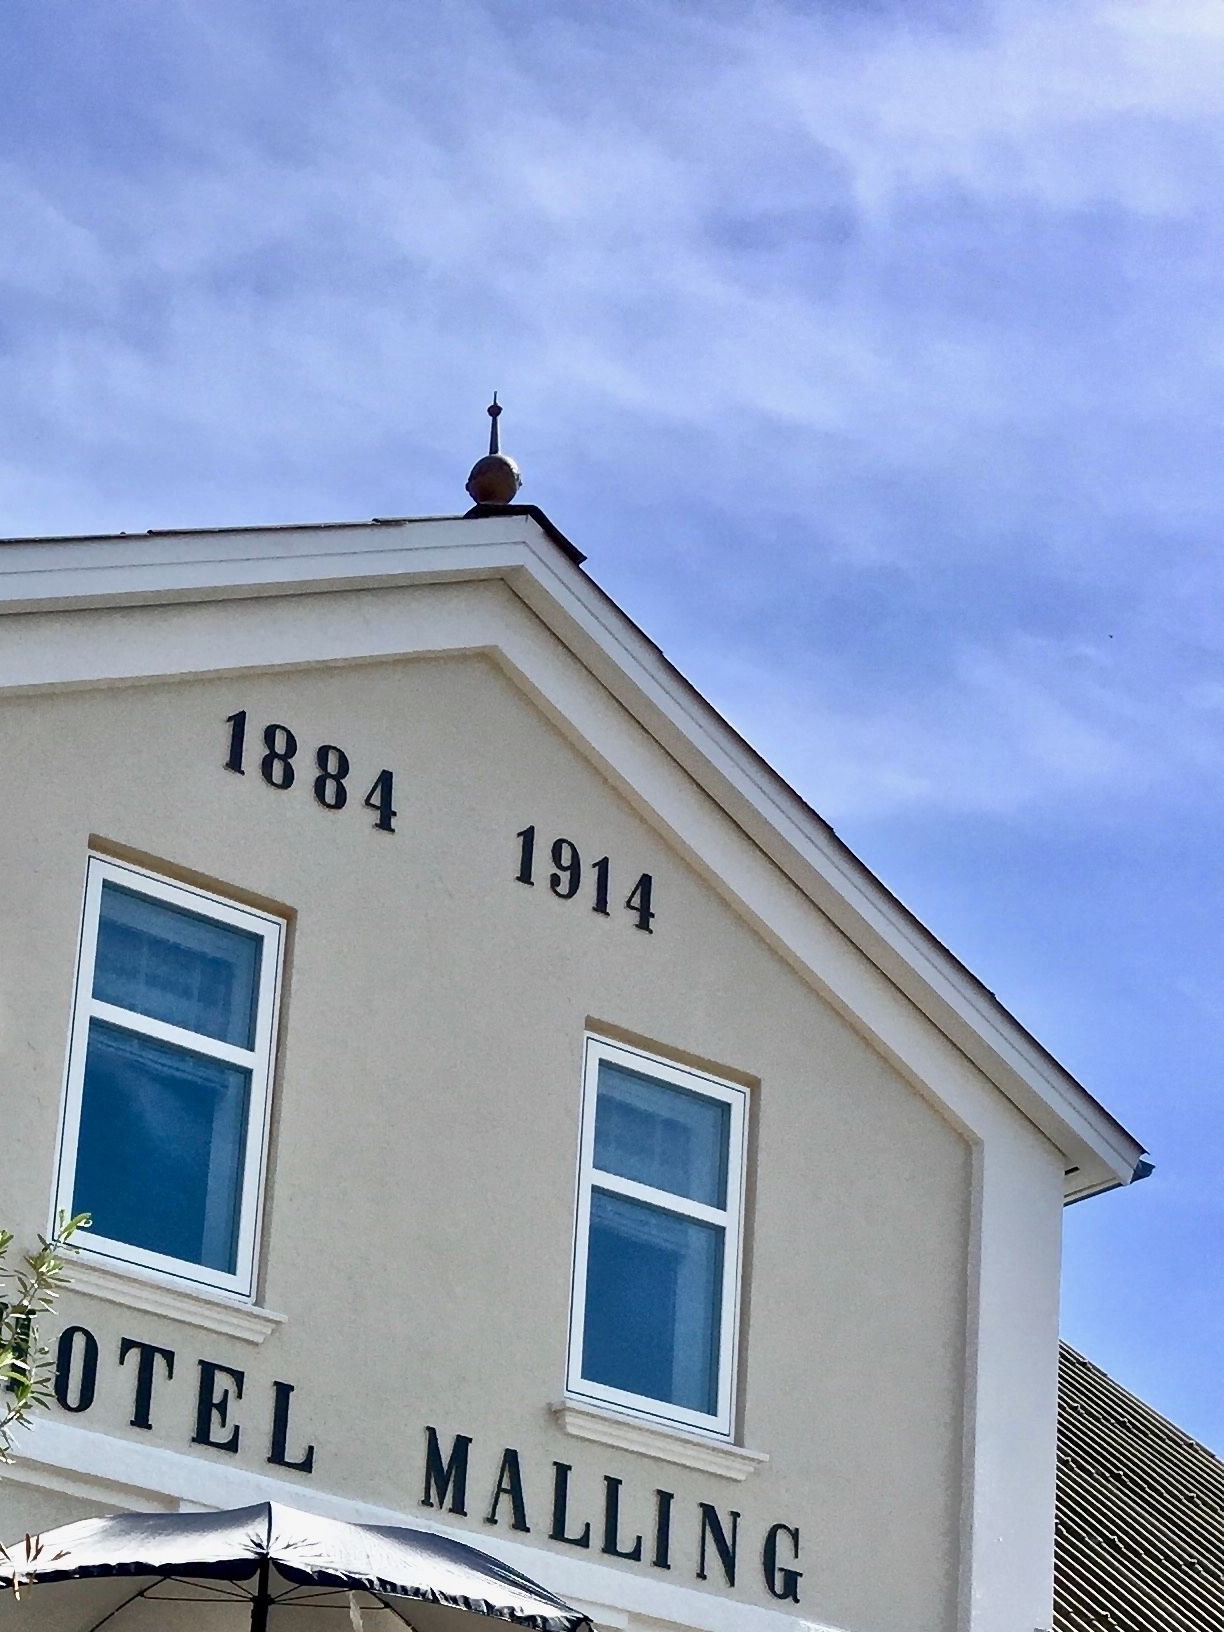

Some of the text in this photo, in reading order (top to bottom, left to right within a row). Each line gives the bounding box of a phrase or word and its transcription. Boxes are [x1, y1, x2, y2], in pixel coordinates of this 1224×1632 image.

[222, 708, 657, 935] 1884 1914
[419, 1424, 805, 1605] MALLING
